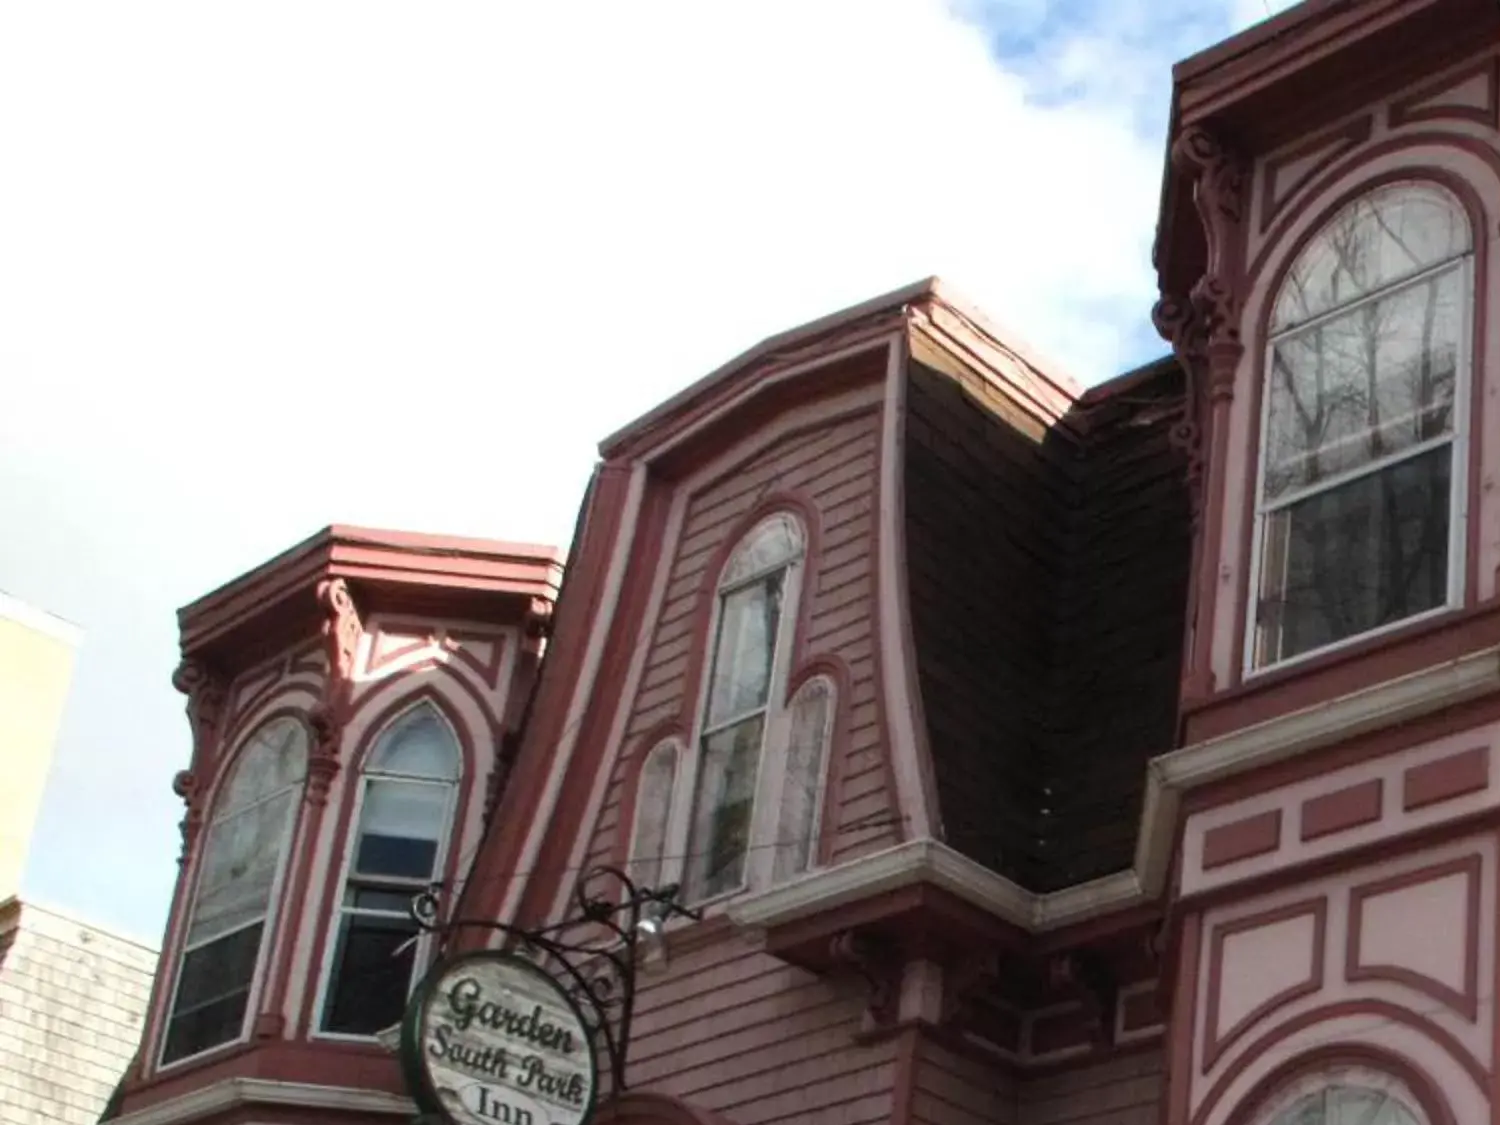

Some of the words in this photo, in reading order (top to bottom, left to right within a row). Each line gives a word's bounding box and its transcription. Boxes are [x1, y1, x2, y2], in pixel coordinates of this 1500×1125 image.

[448, 977, 573, 1053] Garden
[429, 1024, 508, 1082] South
[517, 1055, 584, 1105] Park
